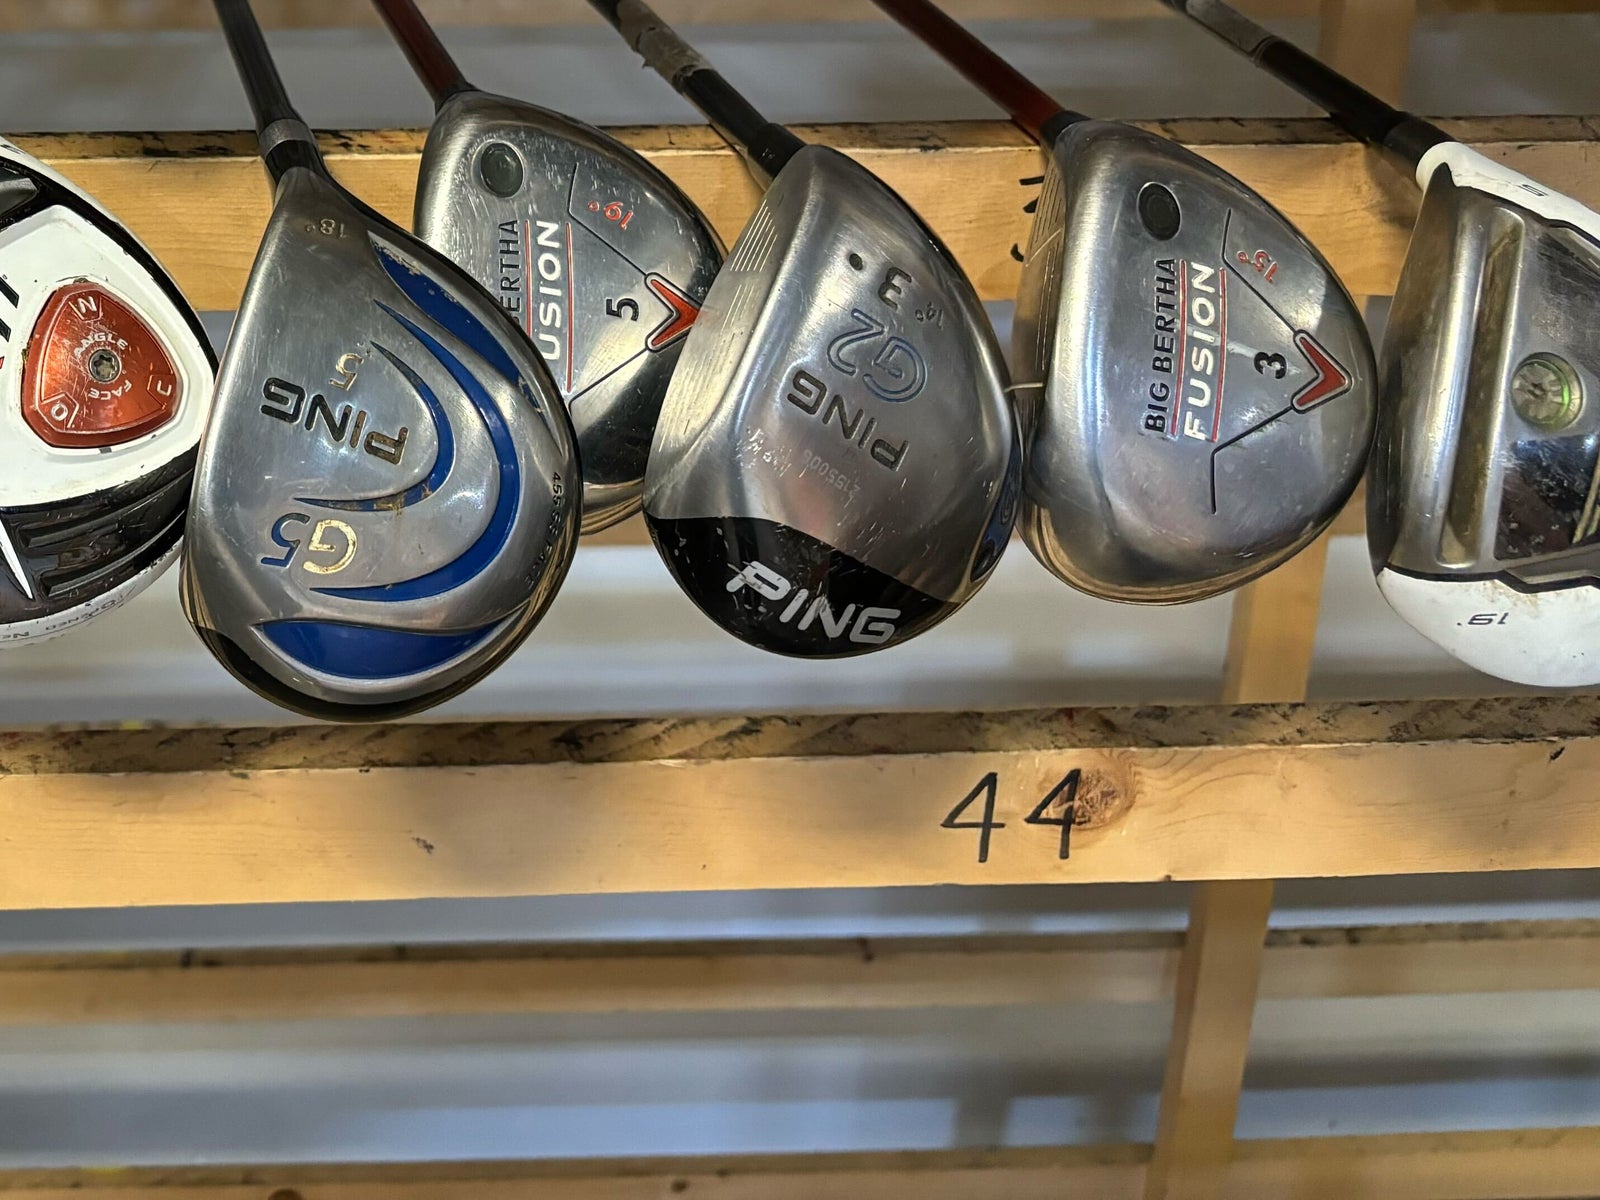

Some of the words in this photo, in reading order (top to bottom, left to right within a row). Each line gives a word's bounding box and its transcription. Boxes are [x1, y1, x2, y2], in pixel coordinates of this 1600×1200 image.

[498, 218, 522, 323] ERTHA
[536, 220, 564, 362] USION
[877, 266, 913, 311] 3
[73, 331, 129, 358] ANGLE
[605, 297, 641, 323] 5
[1151, 257, 1177, 375] BERTHA
[328, 351, 366, 392] 5
[826, 307, 930, 404] G2
[1183, 260, 1216, 441] FUSION
[1253, 350, 1288, 380] 3
[87, 380, 134, 402] FACE
[259, 376, 410, 467] PING
[785, 369, 910, 473] PING
[1144, 380, 1171, 433] BIG
[259, 511, 360, 576] G5
[725, 560, 902, 645] PING
